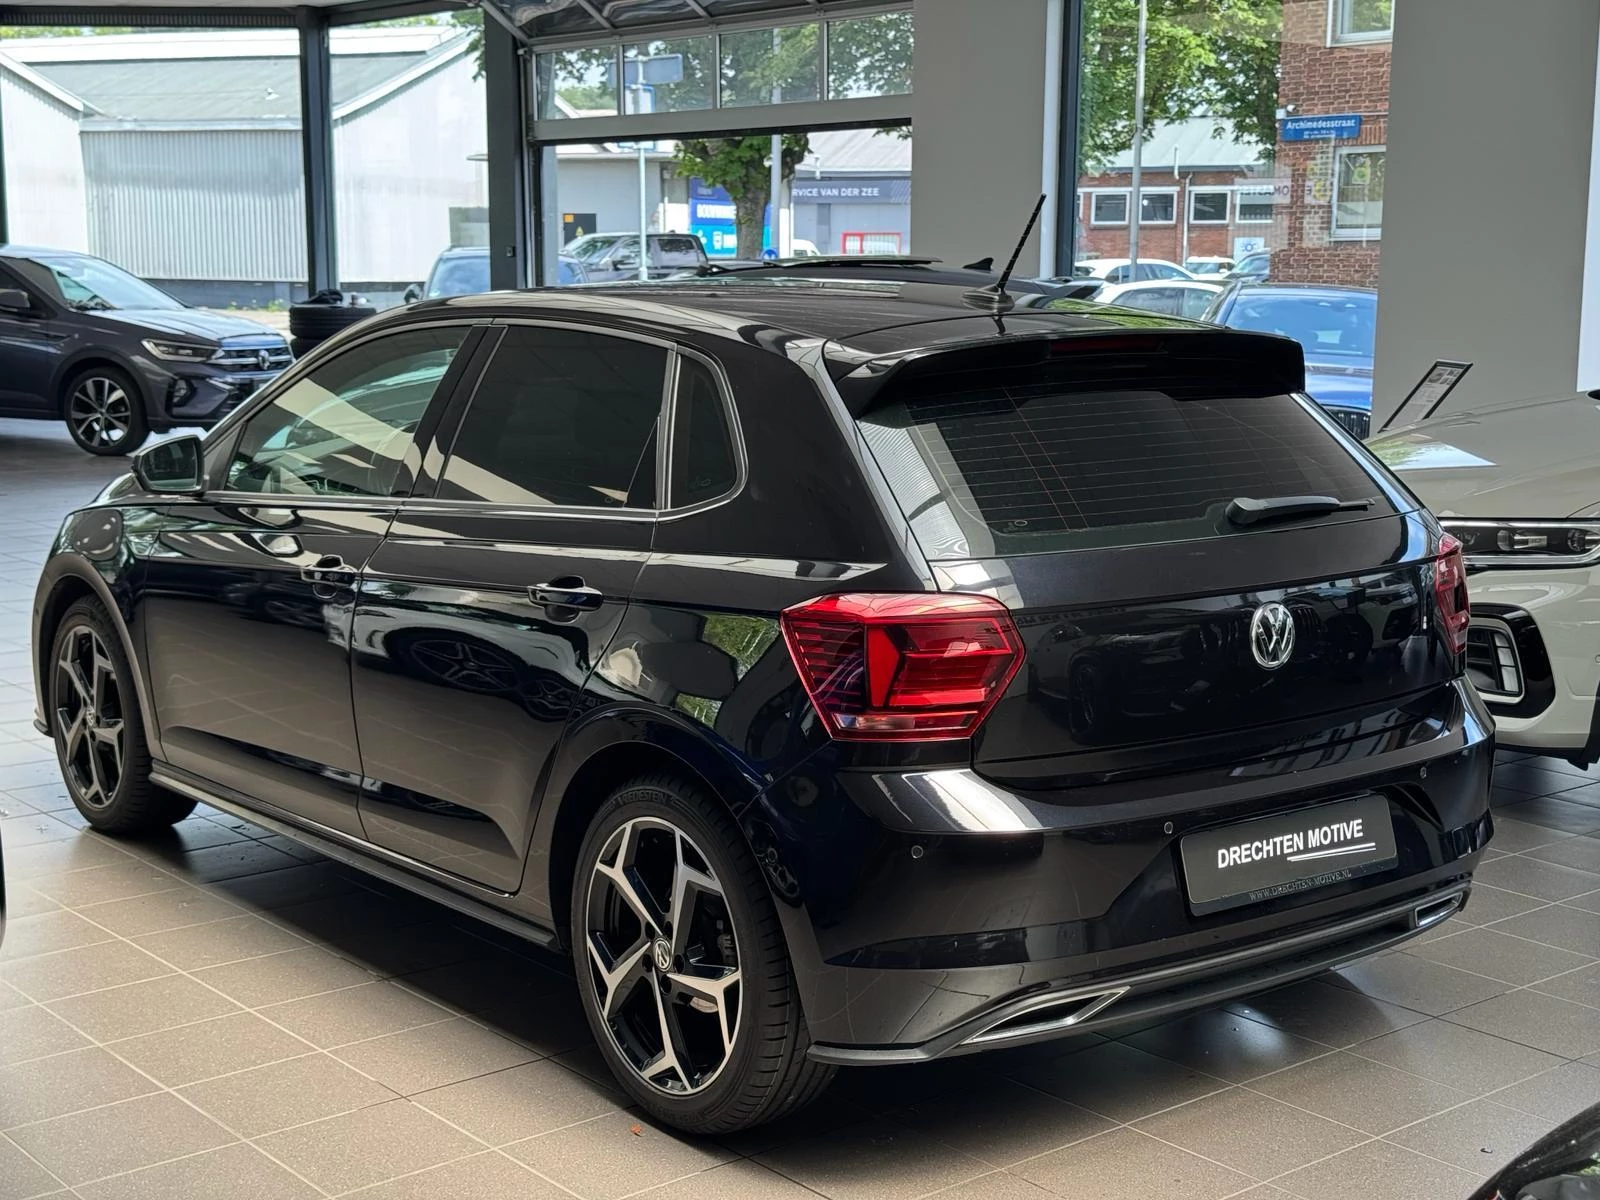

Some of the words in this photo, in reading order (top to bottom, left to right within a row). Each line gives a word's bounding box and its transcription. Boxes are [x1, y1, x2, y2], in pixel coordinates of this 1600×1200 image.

[1286, 119, 1356, 129] Archimedesstraat
[820, 188, 839, 196] VAN
[841, 187, 860, 197] DER
[861, 187, 880, 196] ZEE
[1217, 832, 1304, 868] DRECHTEN
[1308, 819, 1364, 848] MOTIVE
[1249, 869, 1352, 901] WWW.DRECHTEN-MOTIVE.NL
